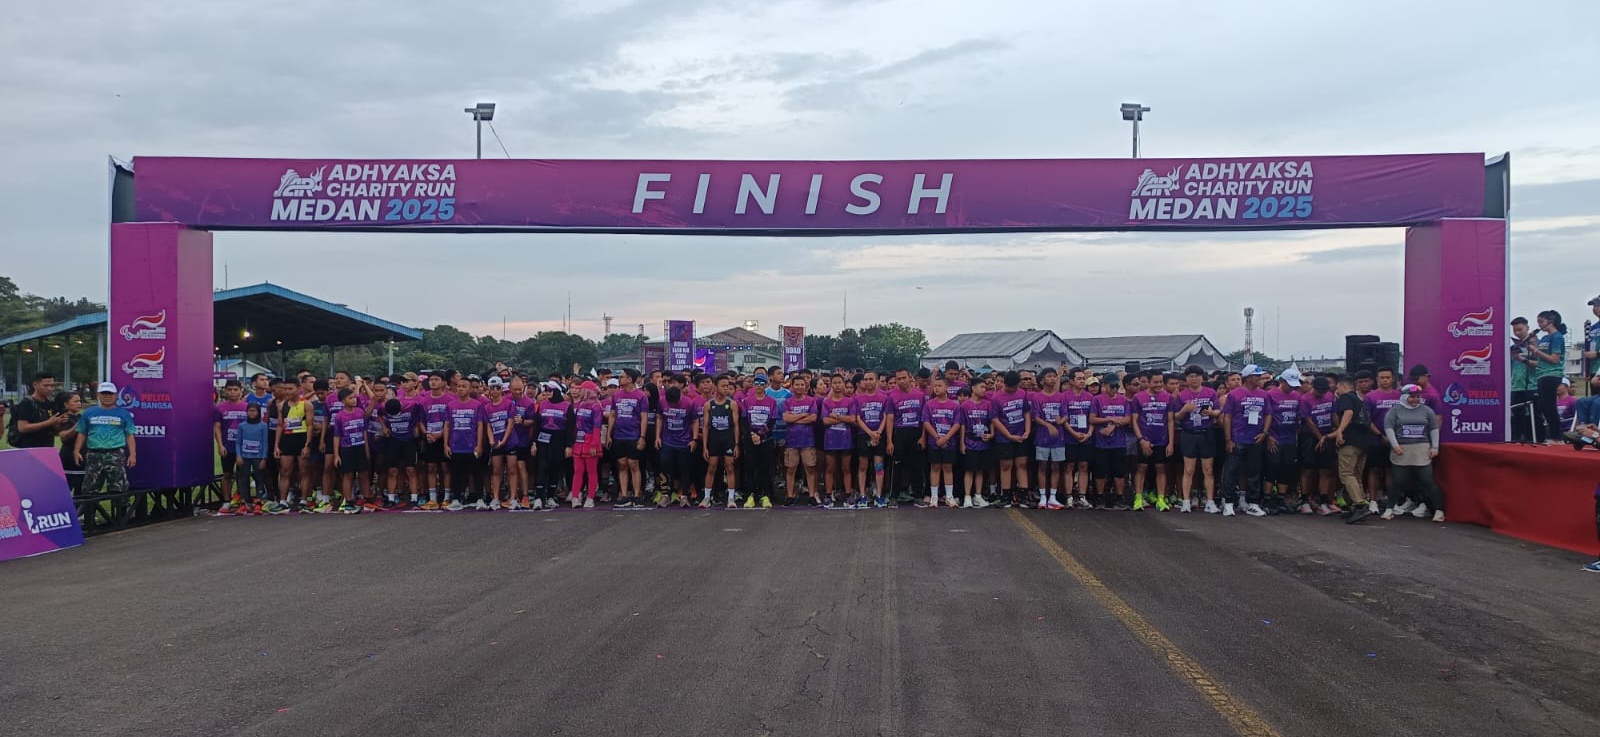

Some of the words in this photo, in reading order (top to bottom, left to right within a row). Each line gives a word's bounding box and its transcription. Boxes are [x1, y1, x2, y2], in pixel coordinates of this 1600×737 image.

[328, 164, 456, 181] ADHYAKSA
[1184, 162, 1313, 179] ADHYAKSA
[326, 182, 412, 197] CHARITY
[414, 182, 455, 197] RUN
[631, 173, 954, 215] FINISH
[1184, 181, 1271, 196] CHARITY
[1272, 180, 1311, 194] RUN
[270, 199, 381, 221] MEDAN
[384, 198, 456, 221] 2025
[1129, 197, 1238, 220] MEDAN
[1242, 196, 1313, 219] 2025
[789, 354, 797, 362] TO
[141, 394, 171, 402] PELITA
[1468, 398, 1500, 406] BANGSA
[1469, 390, 1498, 398] PELITA
